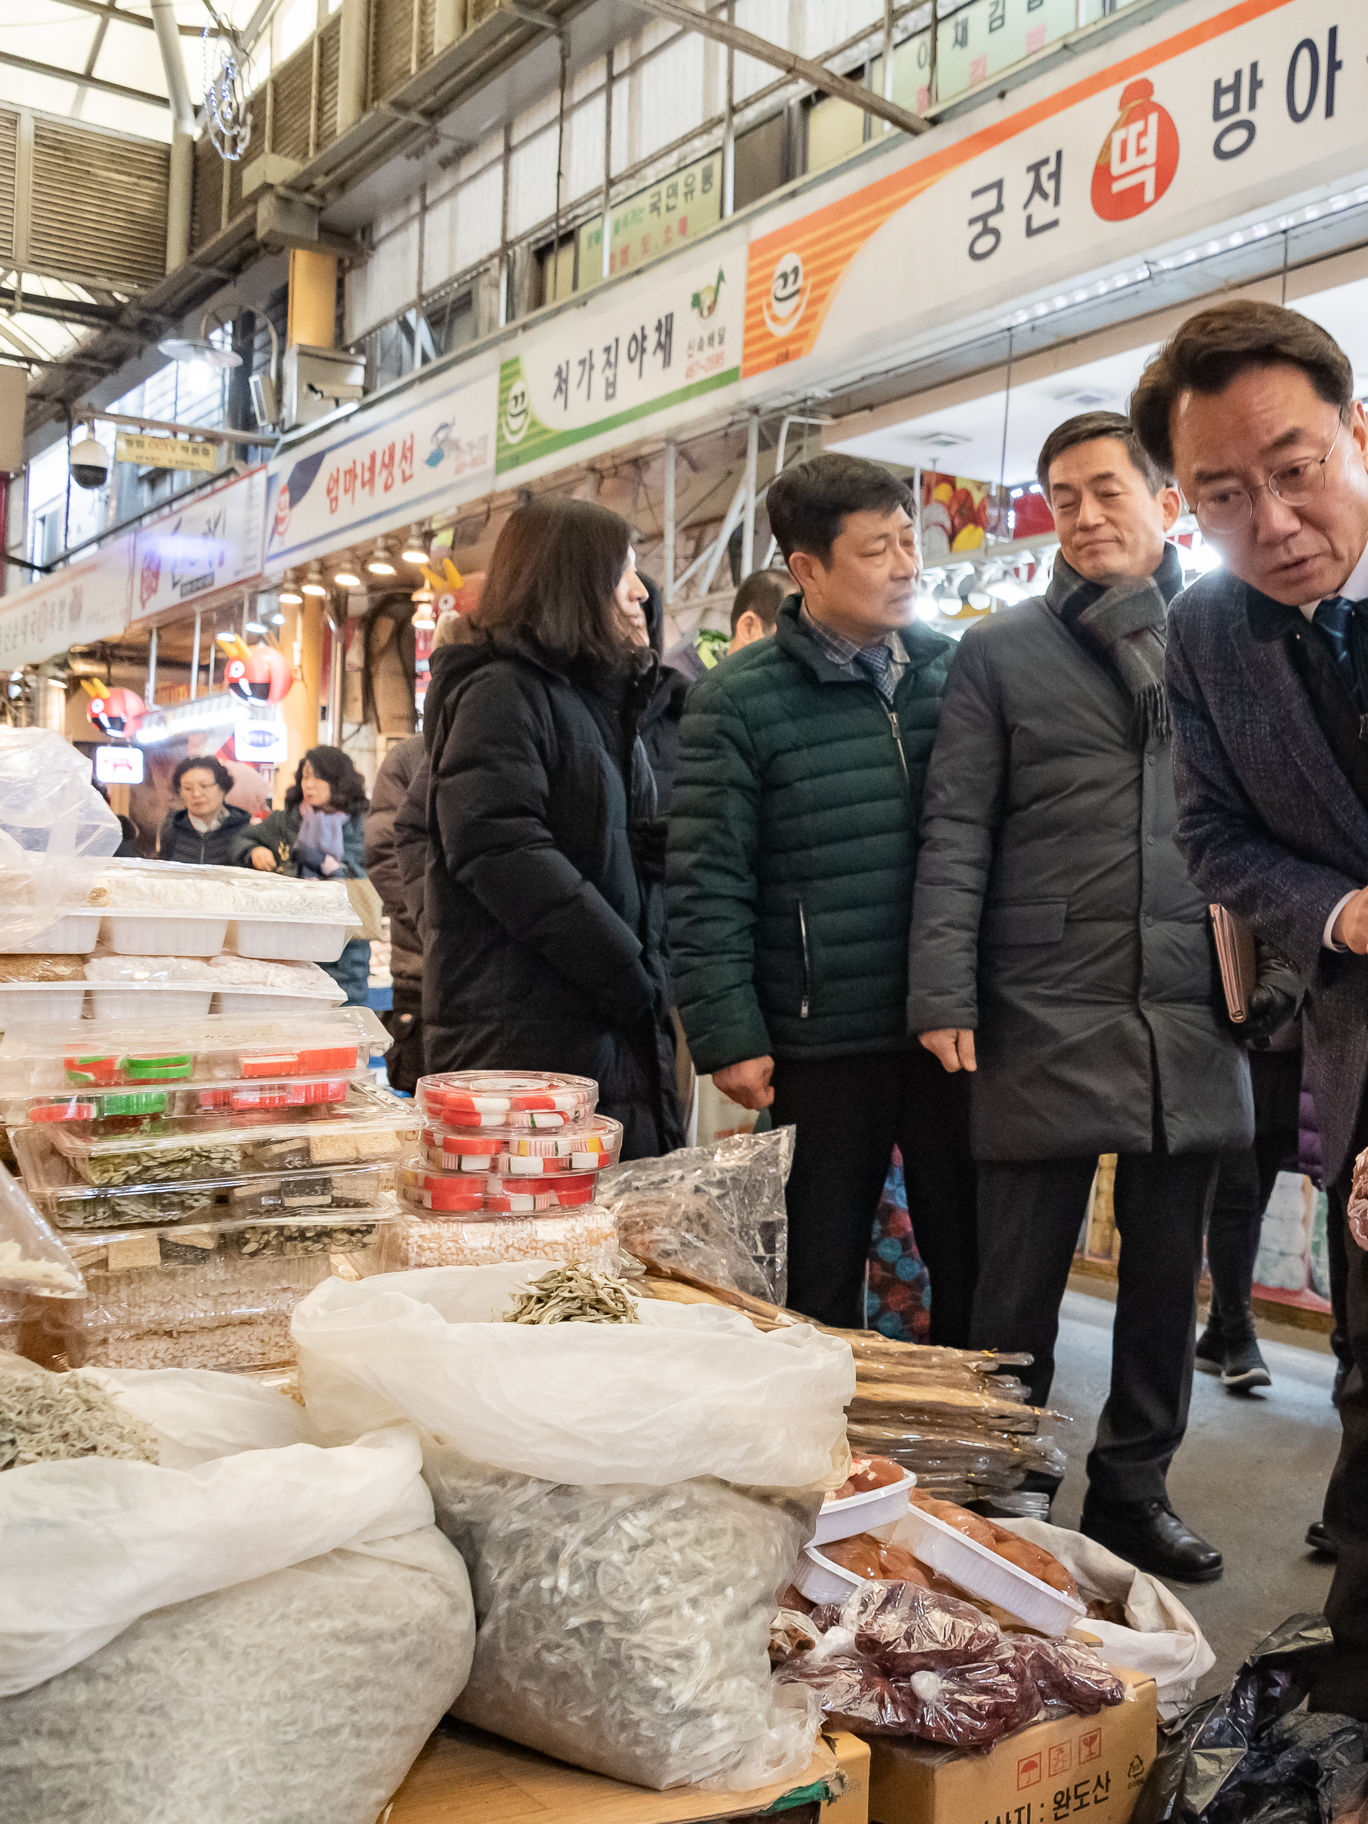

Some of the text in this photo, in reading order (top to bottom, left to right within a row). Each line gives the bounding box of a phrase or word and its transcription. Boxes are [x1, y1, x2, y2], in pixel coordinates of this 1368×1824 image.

[968, 149, 1062, 262] 궁전
[1110, 111, 1159, 204] 떡
[552, 312, 675, 412] 처가집야채
[326, 433, 415, 515] 엄마네생선
[1052, 1770, 1111, 1822] 완도산
